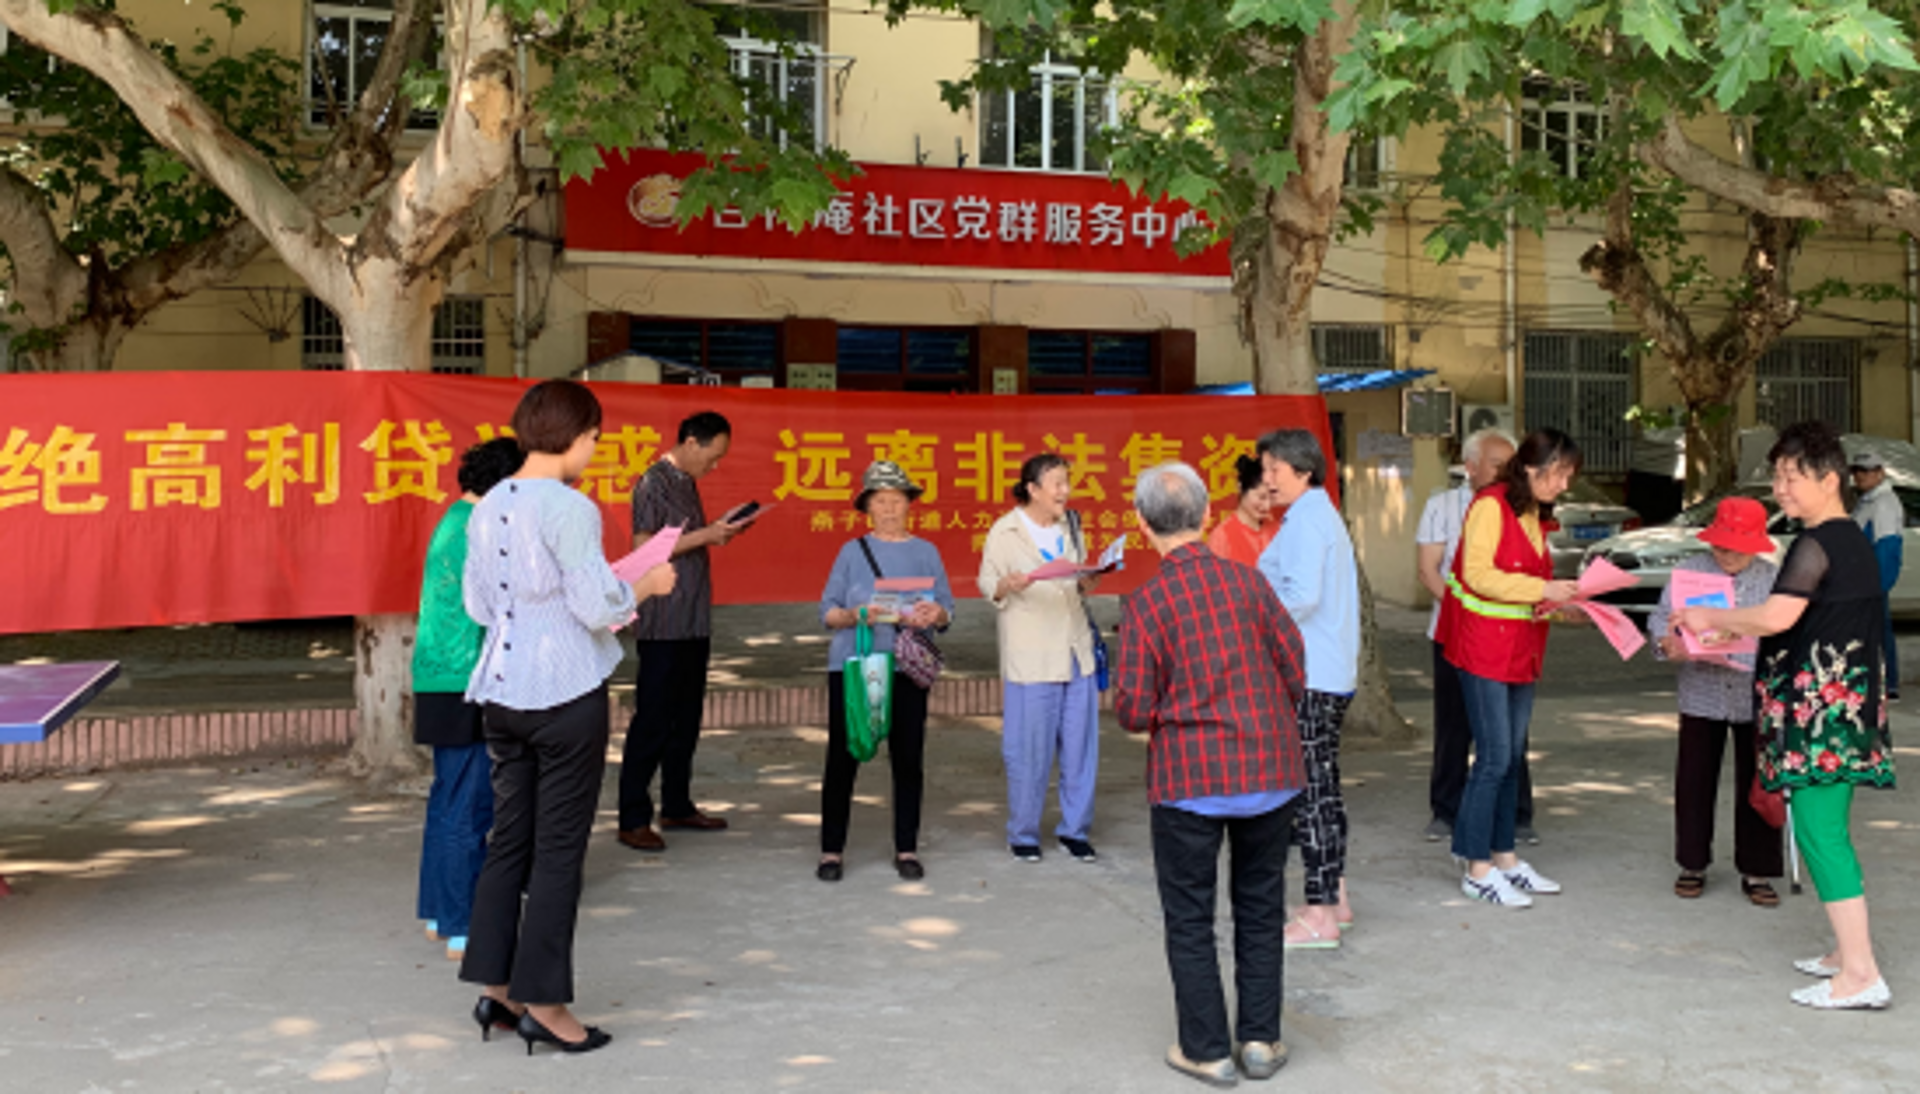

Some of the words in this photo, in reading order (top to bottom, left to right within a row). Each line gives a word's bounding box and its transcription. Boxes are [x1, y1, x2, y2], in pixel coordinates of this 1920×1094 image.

[0, 419, 662, 515] 绝高利贷惑
[773, 428, 1258, 504] 远离非法集资
